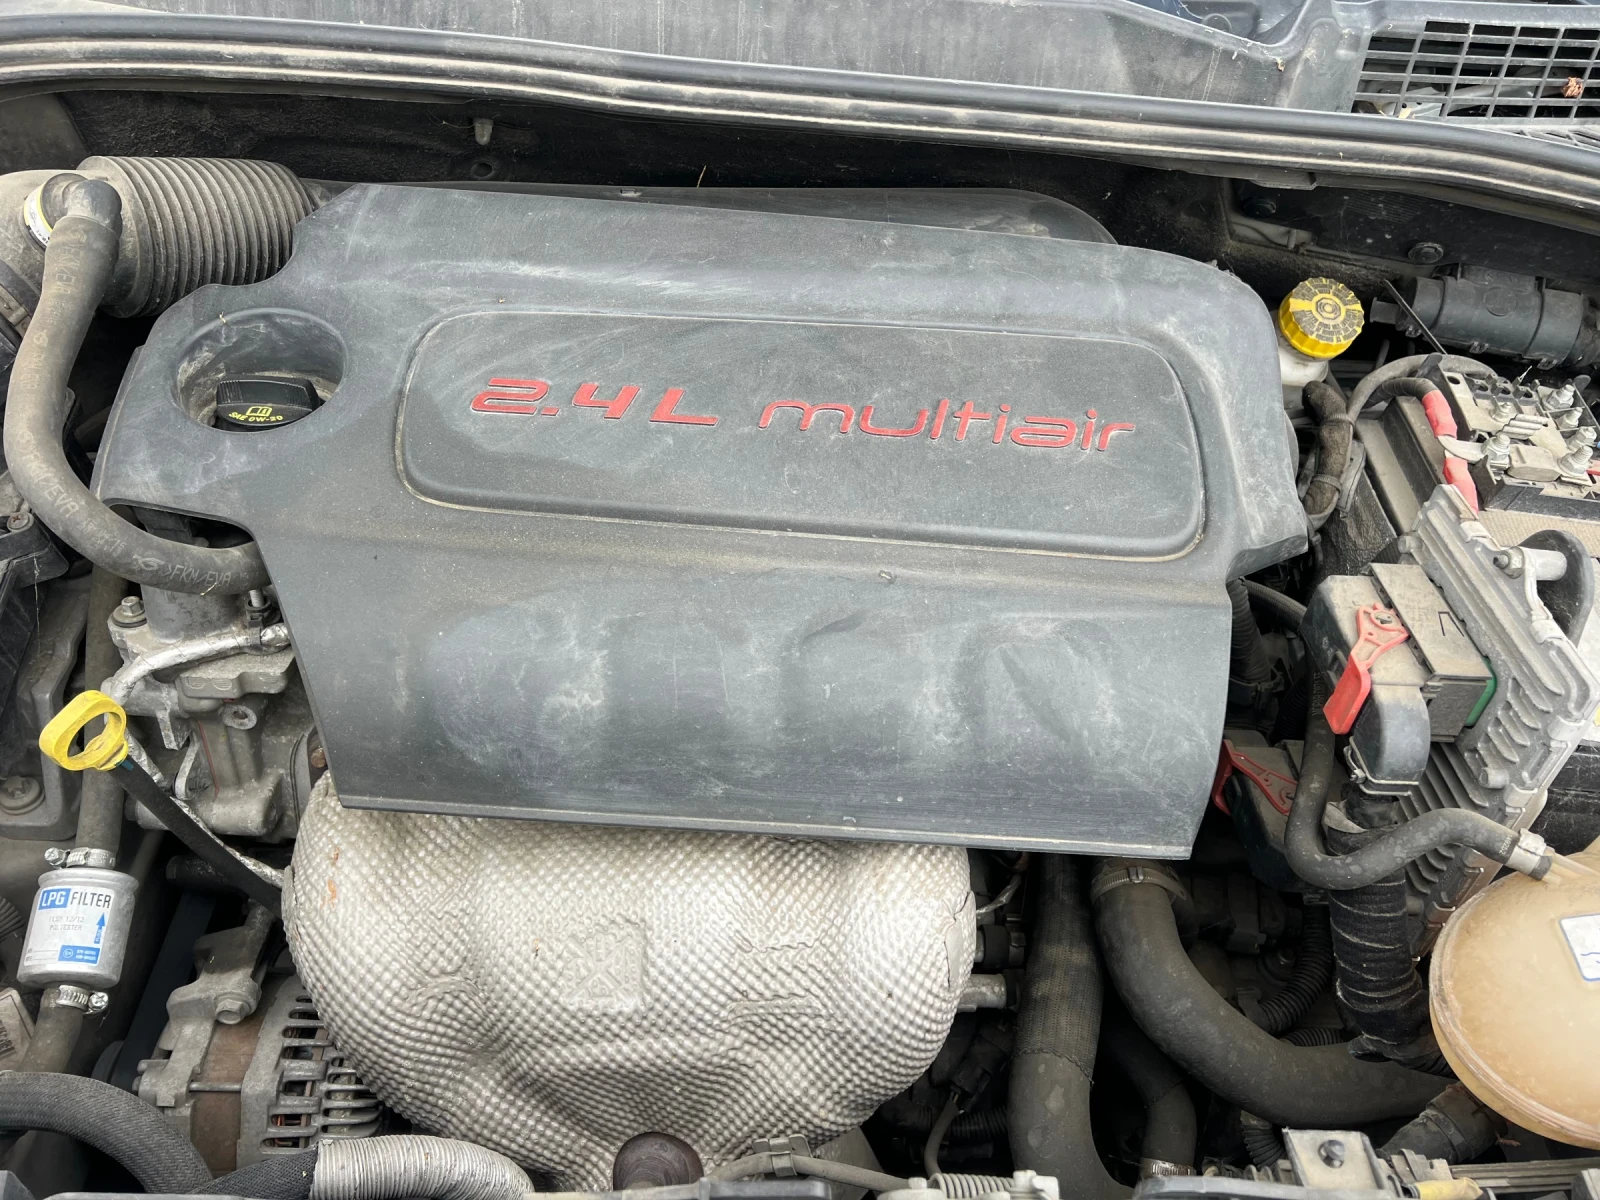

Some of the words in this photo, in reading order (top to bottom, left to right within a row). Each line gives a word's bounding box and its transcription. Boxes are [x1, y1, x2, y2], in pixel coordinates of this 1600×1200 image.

[228, 411, 248, 421] SAE
[758, 398, 1136, 452] multiair
[41, 891, 66, 907] LPG
[70, 891, 112, 909] FILTER
